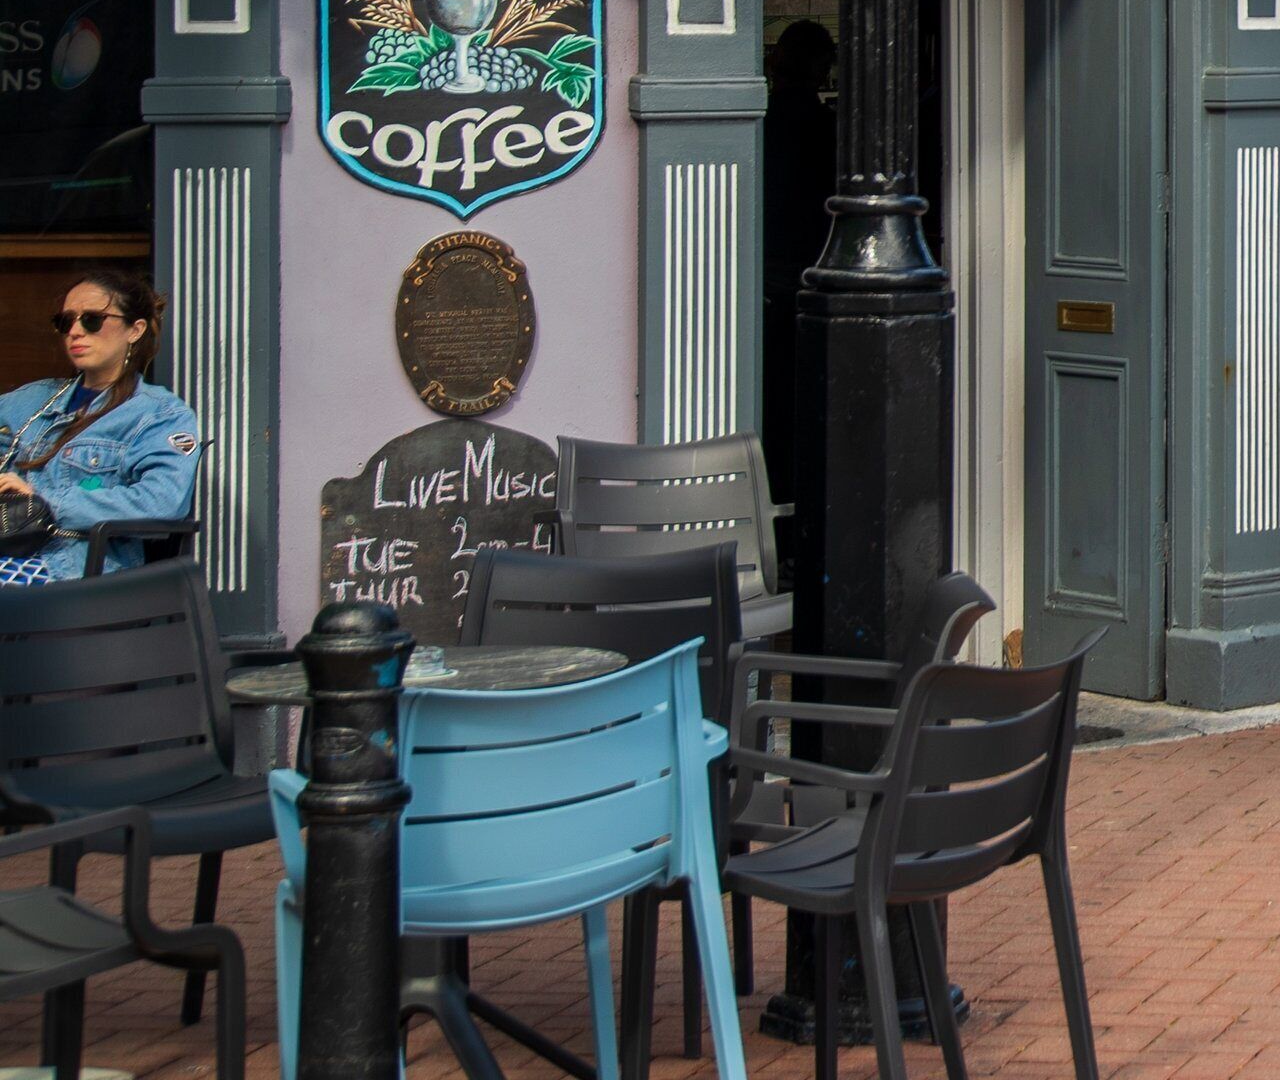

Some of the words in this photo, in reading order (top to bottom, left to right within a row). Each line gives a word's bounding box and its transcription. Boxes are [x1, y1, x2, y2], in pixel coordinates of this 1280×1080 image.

[326, 105, 595, 190] coffee
[435, 234, 496, 249] TITANIC
[448, 398, 496, 412] TRAIL
[334, 535, 420, 575] TUE
